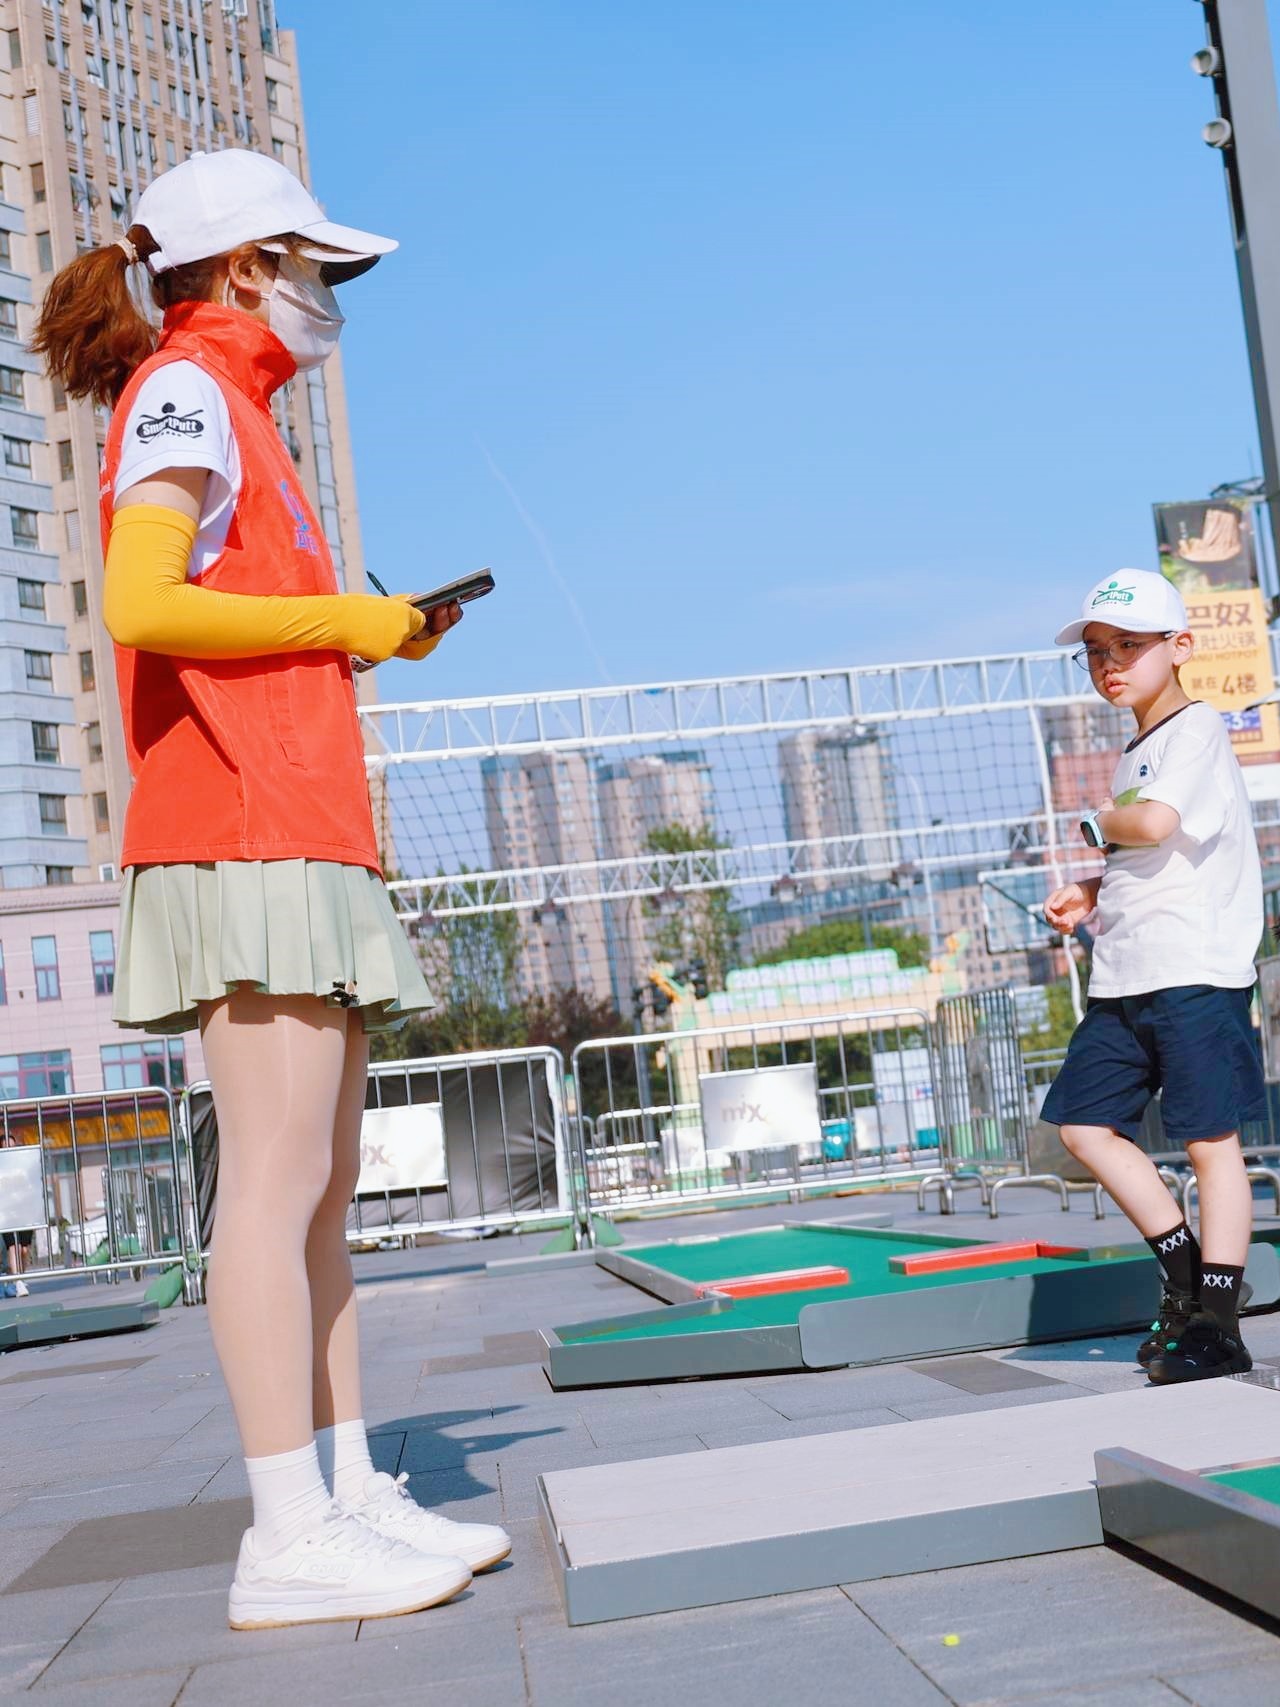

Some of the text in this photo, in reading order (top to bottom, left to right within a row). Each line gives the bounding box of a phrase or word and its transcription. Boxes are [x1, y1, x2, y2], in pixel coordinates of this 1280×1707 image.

[142, 417, 198, 436] SmartPutt
[1195, 631, 1257, 650] 肚火锅
